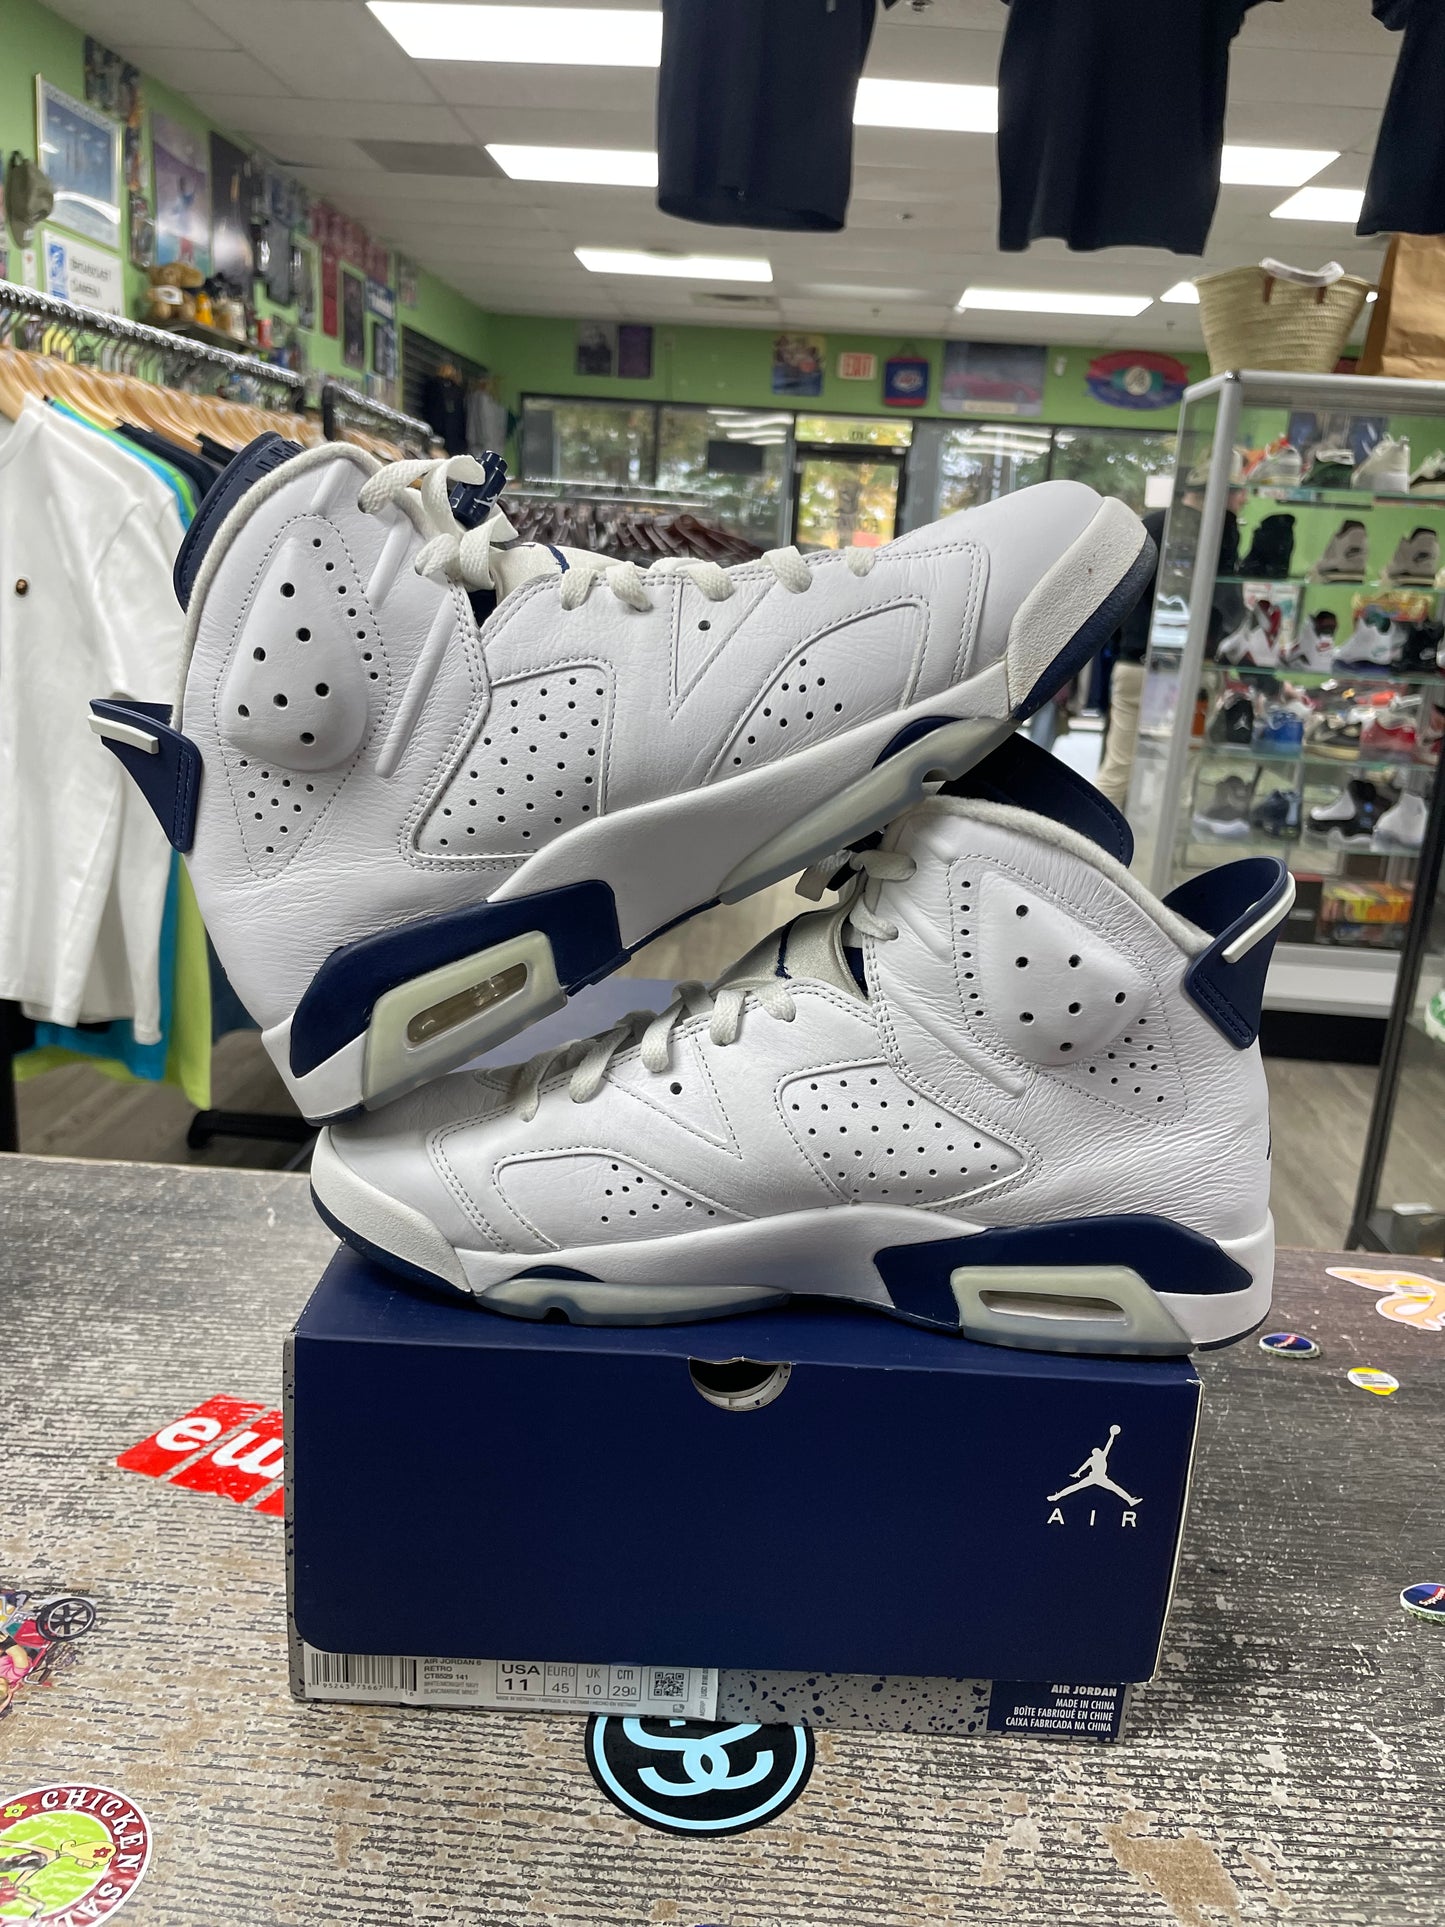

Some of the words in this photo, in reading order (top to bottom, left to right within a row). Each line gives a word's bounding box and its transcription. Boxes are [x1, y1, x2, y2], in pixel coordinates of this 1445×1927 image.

[1047, 1508, 1137, 1527] AIR
[501, 1664, 540, 1675] USA
[547, 1666, 576, 1677] EURO
[586, 1668, 601, 1678] UK
[617, 1669, 634, 1680] cm
[505, 1678, 528, 1691] 11
[552, 1683, 570, 1693] 45
[585, 1684, 602, 1696] 10
[1051, 1684, 1070, 1694] AIR
[1073, 1685, 1118, 1697] JORDAN
[1055, 1698, 1078, 1709] MADE
[1079, 1699, 1089, 1709] IN
[1090, 1700, 1115, 1711] CHINA
[1013, 1705, 1036, 1717] BOÎTE
[1077, 1710, 1089, 1719] EN
[1089, 1711, 1113, 1722] CHINE
[1005, 1716, 1029, 1727] CAIXA
[1030, 1718, 1073, 1730] FABRICADA
[1074, 1721, 1086, 1730] NA
[1087, 1722, 1112, 1732] CHINA
[41, 1788, 144, 1870] CHICKEN
[40, 1882, 123, 1927] SAL
